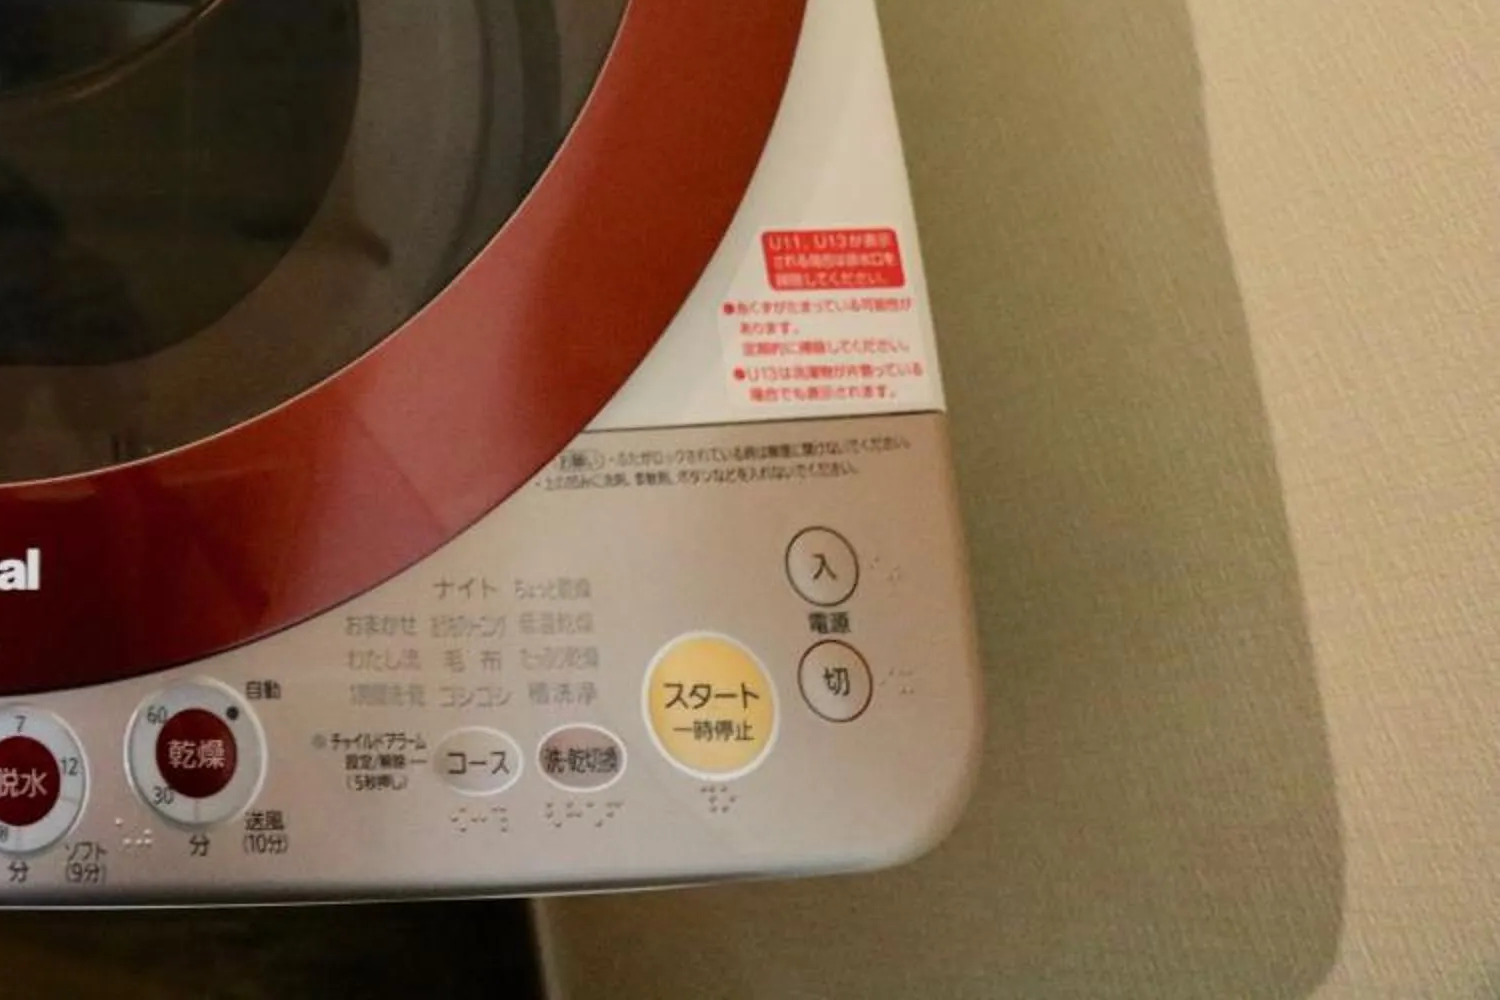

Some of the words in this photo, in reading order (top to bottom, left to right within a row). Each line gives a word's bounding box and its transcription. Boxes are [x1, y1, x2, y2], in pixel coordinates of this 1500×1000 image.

[812, 553, 837, 581] 入
[432, 577, 498, 600] ナイト
[345, 615, 418, 637] おまかせ
[808, 611, 851, 634] 電源
[245, 680, 282, 701] 自動
[823, 667, 851, 697] 切
[663, 682, 760, 710] スタート
[15, 714, 26, 735] 7
[147, 706, 168, 725] 60
[673, 720, 755, 742] 一時停止
[168, 739, 226, 770] 乾燥
[448, 751, 510, 775] コース
[60, 756, 79, 776] 12
[154, 787, 174, 806] 30
[245, 810, 285, 831] 送風
[190, 836, 210, 857] 分
[8, 862, 30, 884] 分
